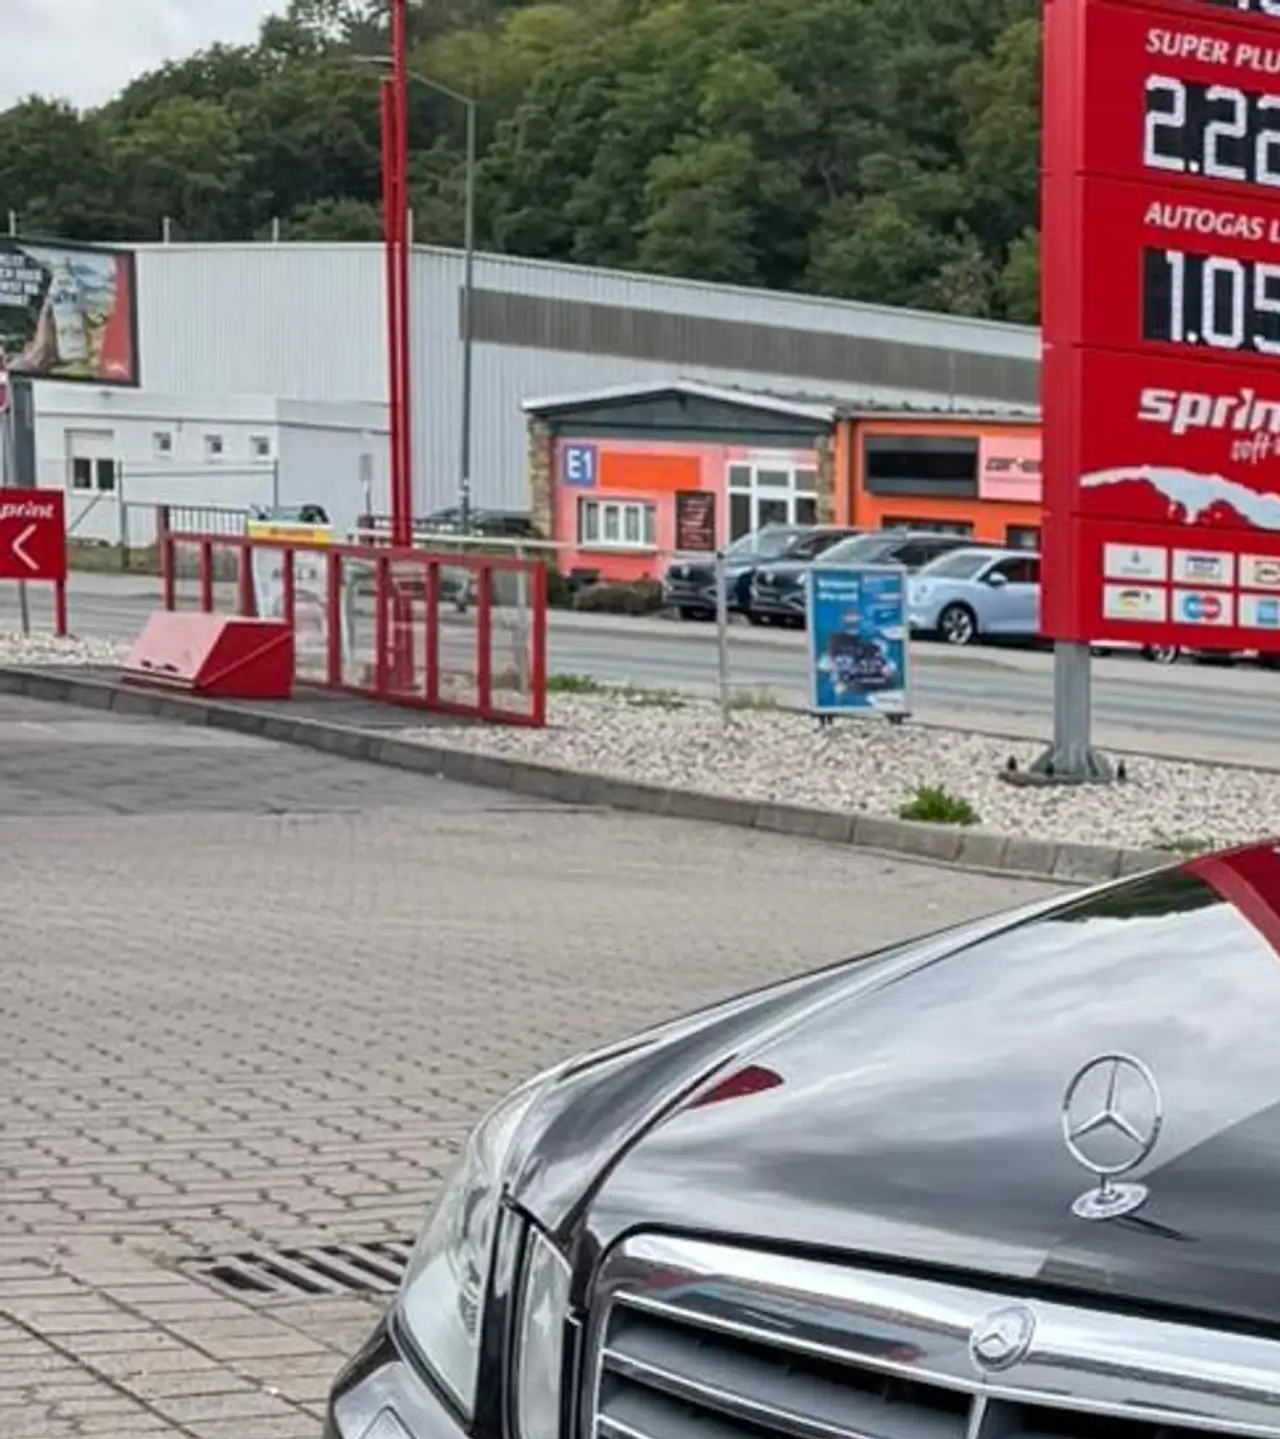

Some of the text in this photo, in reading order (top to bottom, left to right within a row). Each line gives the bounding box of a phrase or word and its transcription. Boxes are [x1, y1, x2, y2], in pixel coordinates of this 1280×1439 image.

[1145, 29, 1228, 65] SUPER
[1144, 201, 1264, 240] AUTOGAS
[567, 449, 593, 480] E1
[0, 499, 55, 521] print
